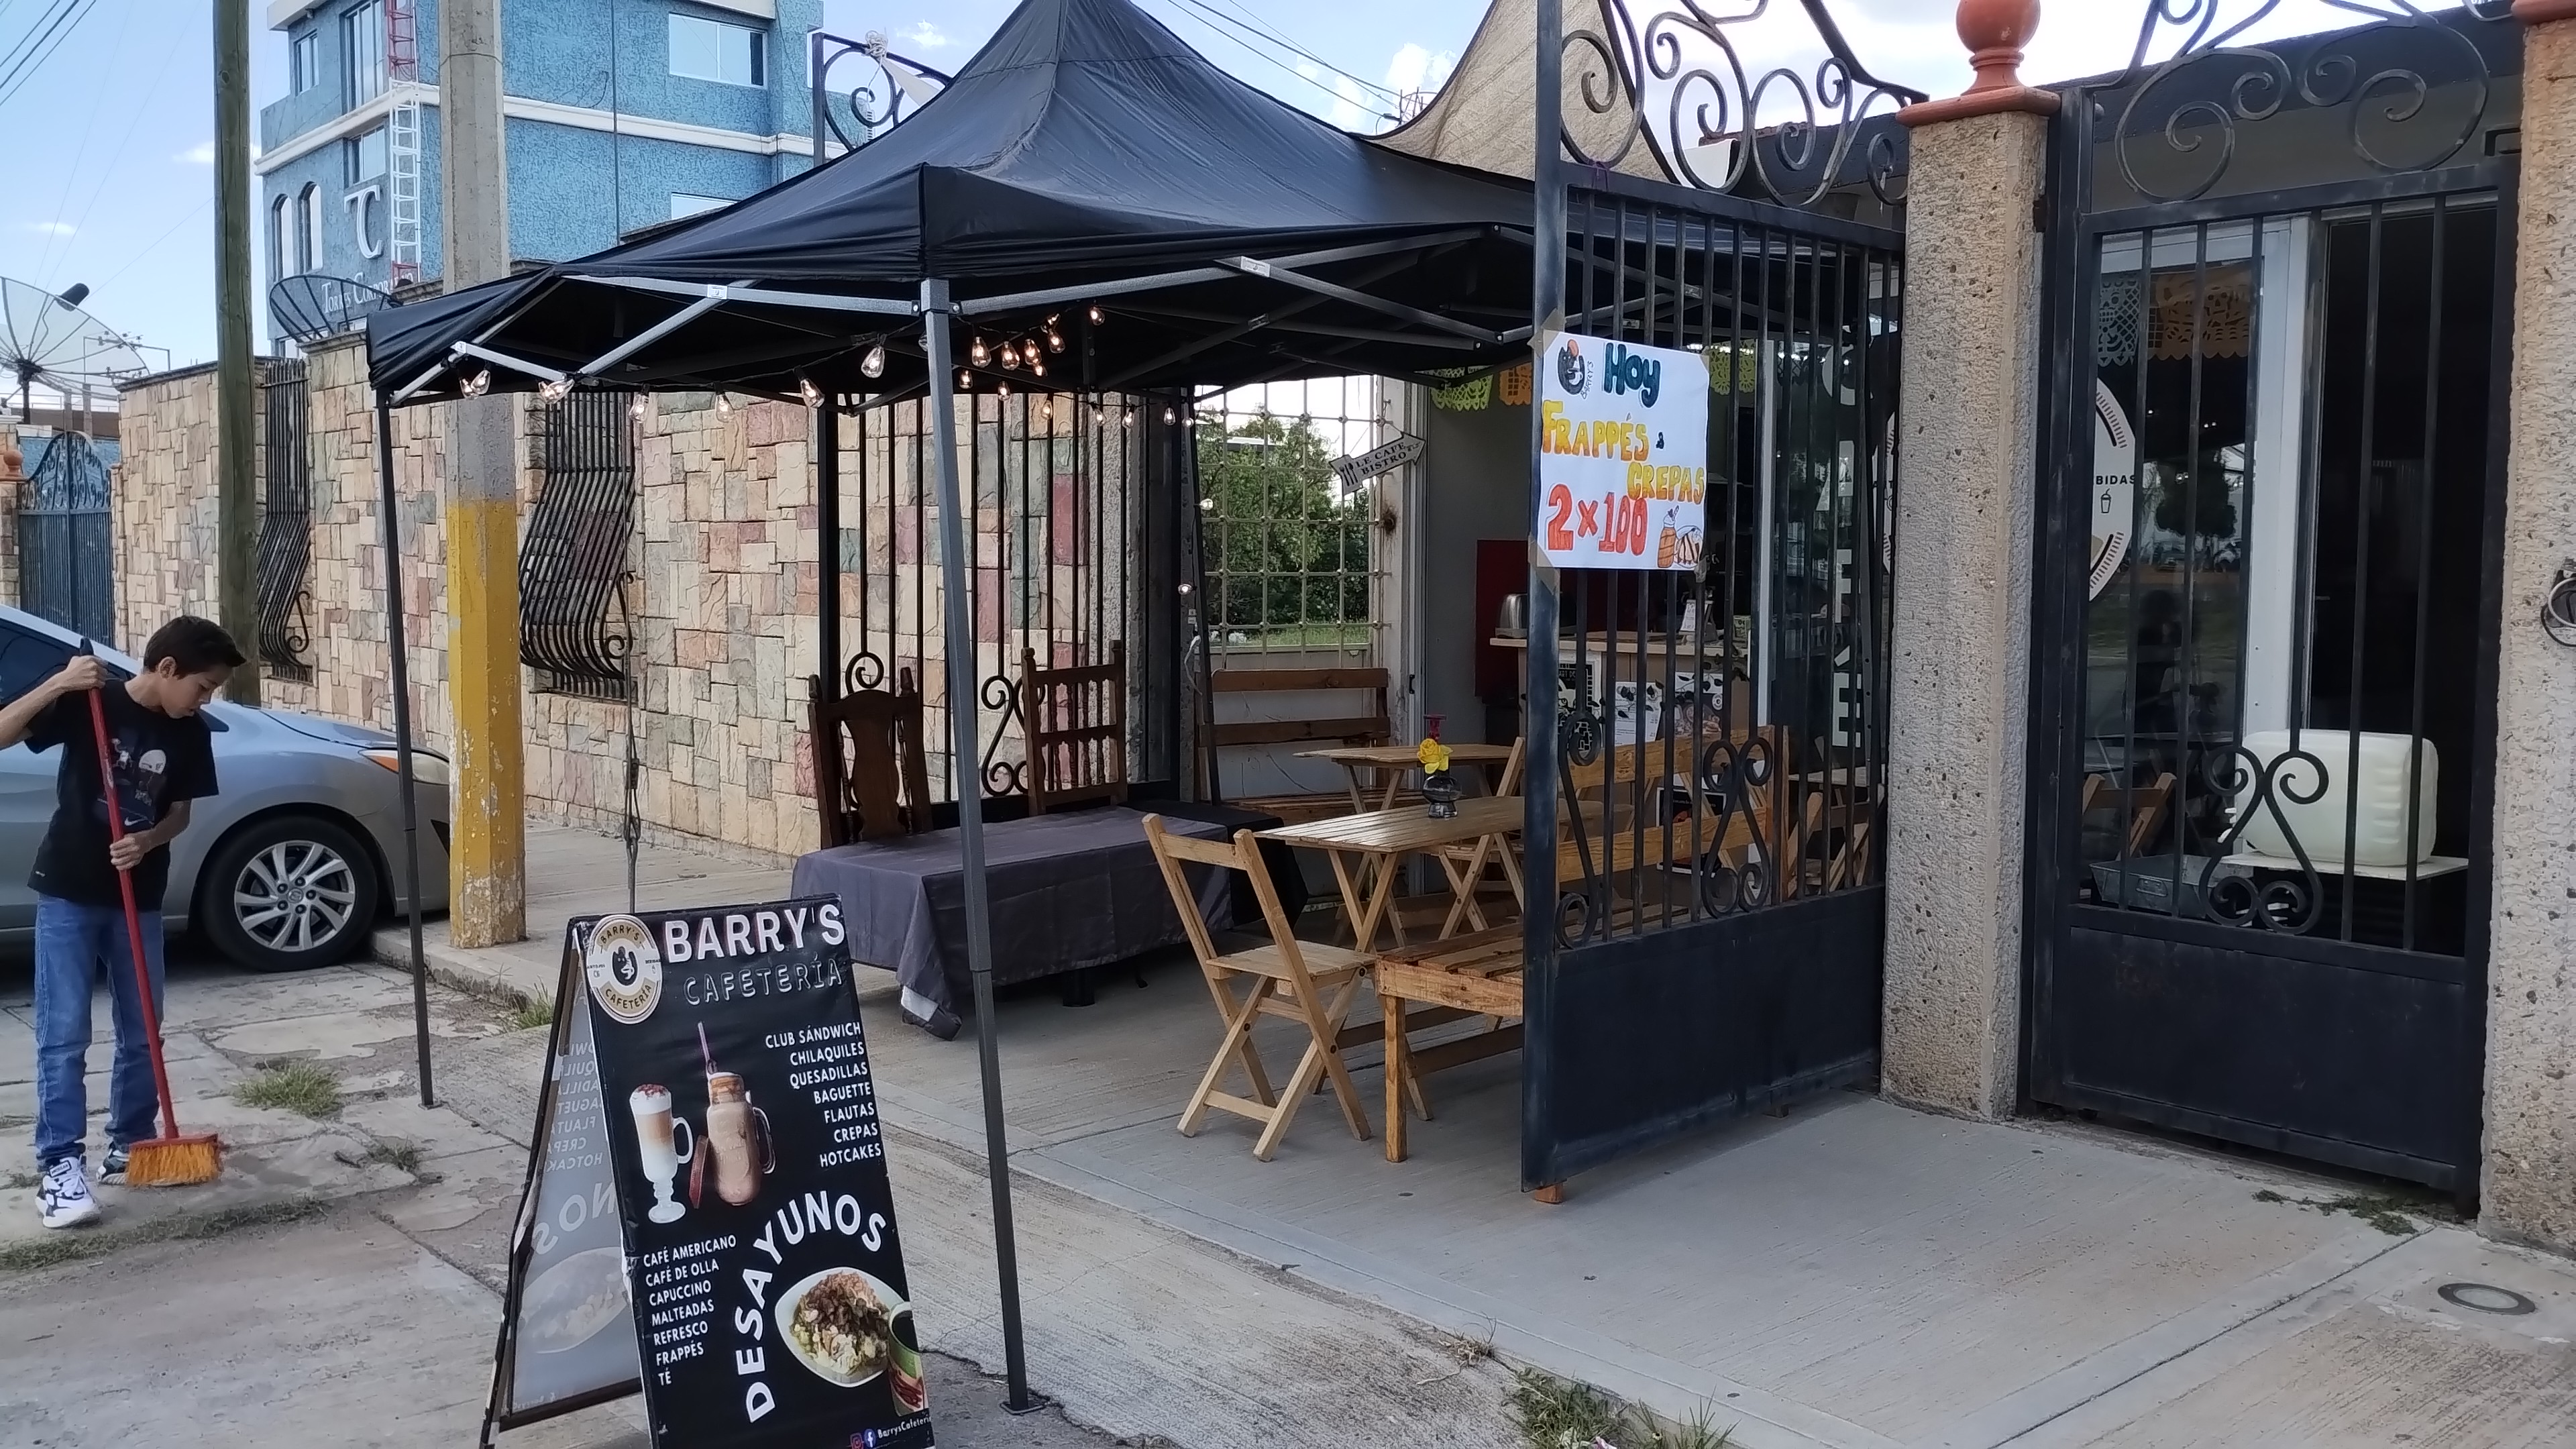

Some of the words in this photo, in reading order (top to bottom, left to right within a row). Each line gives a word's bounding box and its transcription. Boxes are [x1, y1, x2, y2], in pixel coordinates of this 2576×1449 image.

[1603, 342, 1661, 408] Hoy
[1542, 400, 1650, 461] FRAPPÉS
[1355, 457, 1371, 468] LE
[1360, 451, 1406, 474] BISTRO
[1627, 462, 1705, 504] CREPAS
[2096, 475, 2135, 484] BIDAS
[600, 925, 639, 944] BARRY'S
[665, 904, 845, 963] BARRY'S
[684, 951, 842, 1005] CAFETERÍA
[606, 984, 651, 1009] CAFETERÍA
[765, 1032, 795, 1048] CLUB
[799, 1022, 861, 1044] SÁNDWICH
[790, 1041, 864, 1066] CHILAQUILES
[790, 1062, 867, 1089] QUESADILLAS
[814, 1081, 871, 1104] BAGUETTE
[824, 1102, 875, 1124] FLAUTAS
[834, 1122, 878, 1142] CREPAS
[819, 1142, 881, 1167] HOTCAKES
[643, 1246, 669, 1267] CAFÉ
[672, 1234, 737, 1261] AMERICANO
[645, 1265, 672, 1287] CAFÉ
[675, 1265, 688, 1280] DE
[690, 1258, 719, 1276] OLLA
[649, 1279, 711, 1305] CAPUCCINO
[651, 1299, 714, 1326] MALTEADAS
[735, 1191, 886, 1423] DESAYUNOS
[653, 1320, 708, 1346] REFRESCO
[656, 1340, 704, 1366] FRAPPÉS
[658, 1366, 672, 1386] TÉ
